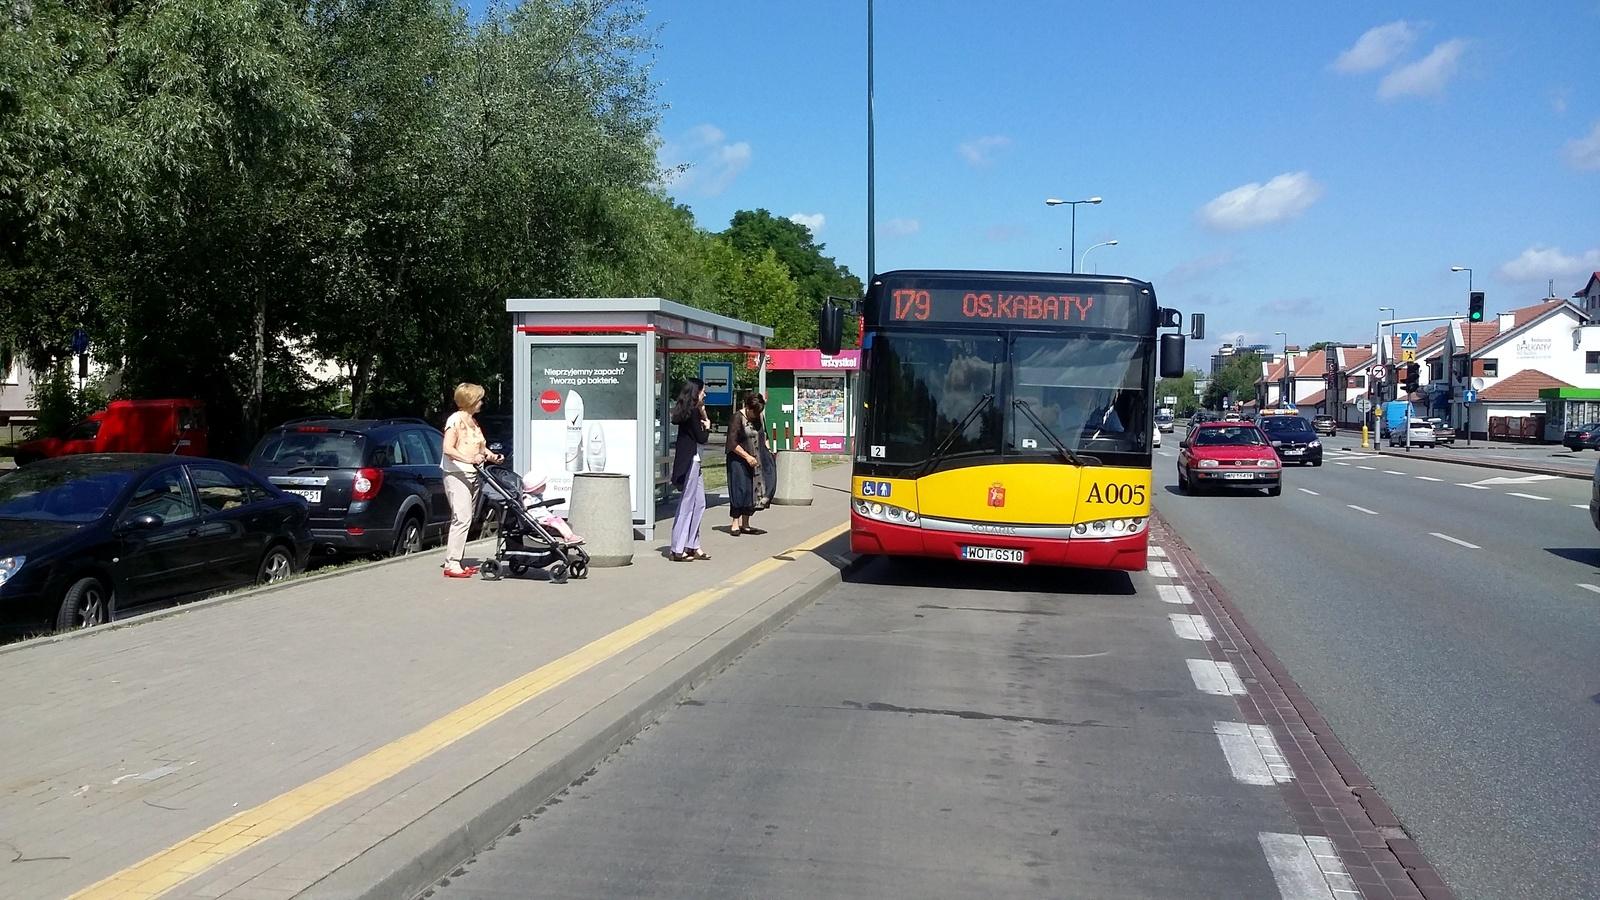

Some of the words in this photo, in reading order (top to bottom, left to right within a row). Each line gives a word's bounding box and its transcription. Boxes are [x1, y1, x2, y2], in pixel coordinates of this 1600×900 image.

[893, 290, 931, 320] 179
[962, 293, 1093, 321] OS.KABATY
[544, 368, 593, 376] Nieprzyjemny
[593, 367, 625, 375] zapach?
[549, 377, 576, 385] Tworzą
[577, 378, 587, 386] go
[587, 376, 620, 385] bakterie.
[875, 446, 881, 456] 2
[1085, 482, 1145, 506] A005
[969, 523, 1016, 535] SOLARIS
[969, 547, 992, 559] WOT
[995, 549, 1023, 562] GS10
